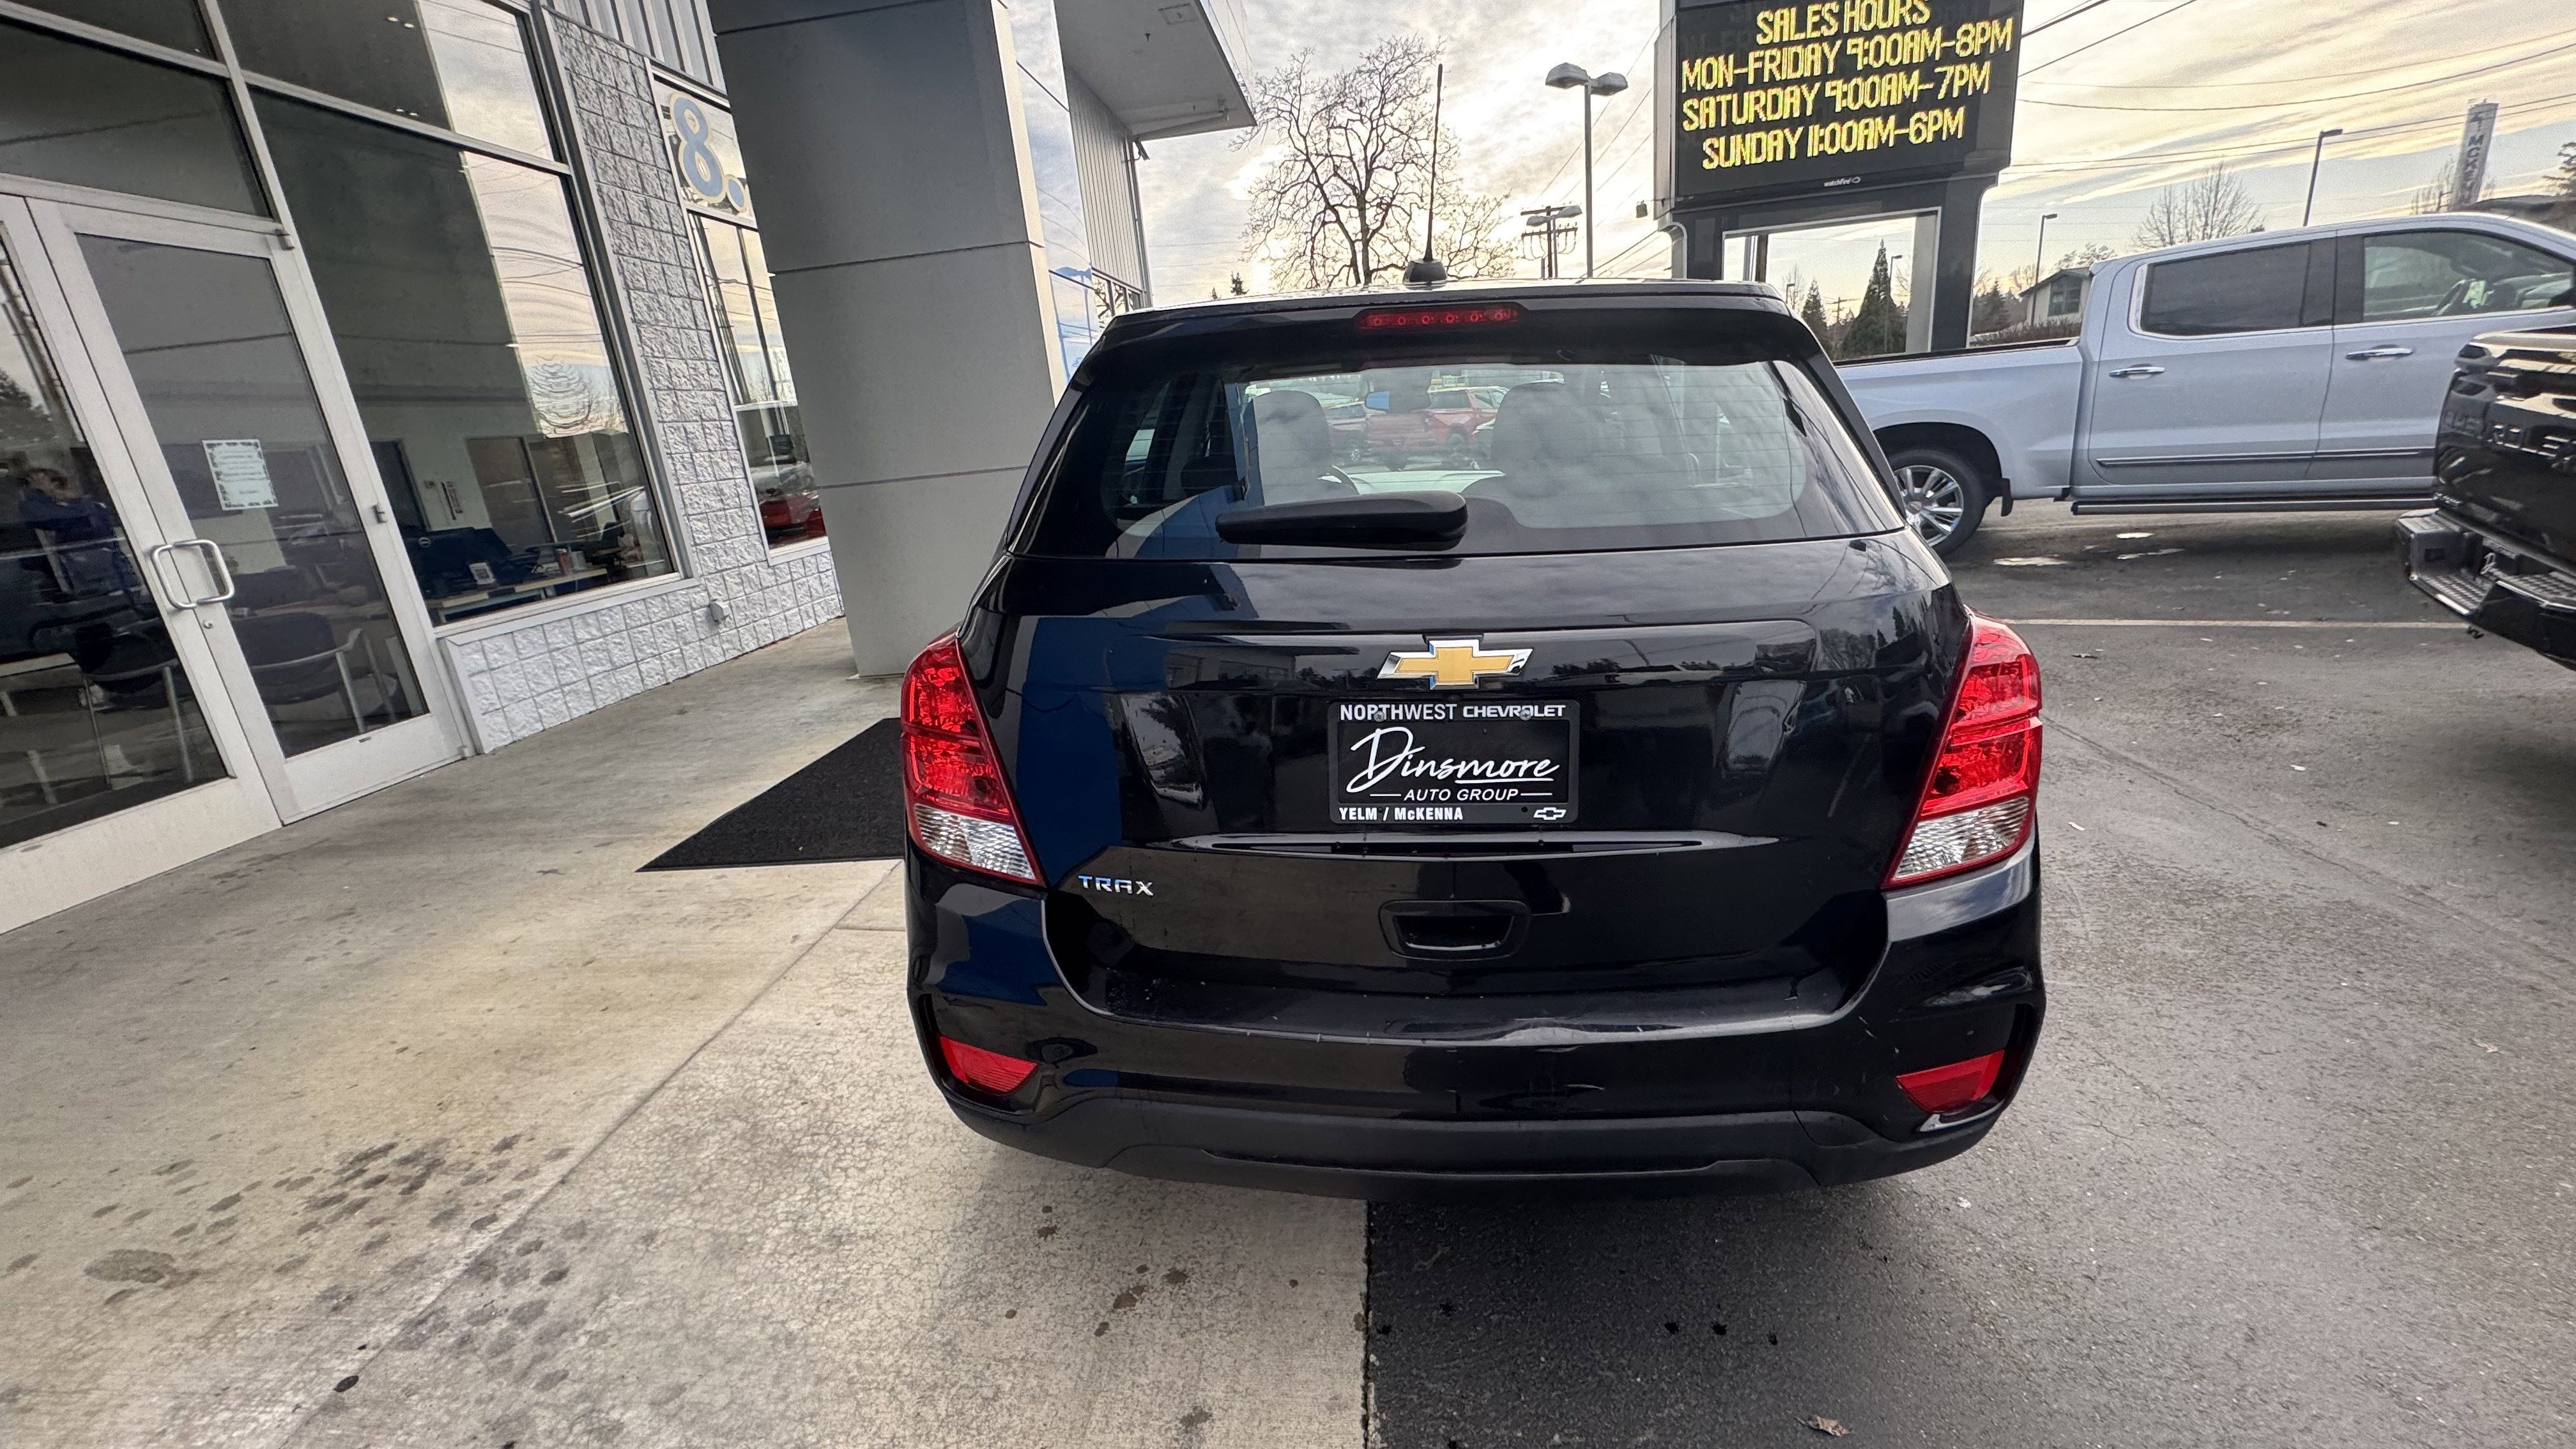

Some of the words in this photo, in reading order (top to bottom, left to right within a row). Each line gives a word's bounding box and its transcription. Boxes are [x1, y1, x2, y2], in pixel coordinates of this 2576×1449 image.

[1756, 6, 1840, 45] SALES
[1843, 0, 1931, 34] HOURS
[1681, 39, 1843, 93] MON-FRIDAY
[1846, 17, 2014, 70] 9:00AM-8PM
[1682, 82, 1818, 132] SATURDAY
[1825, 60, 1992, 114] 9:00AM-7PM
[1701, 126, 1805, 170] SUNDAY
[1807, 106, 1966, 157] 11:00AM-6PM
[1340, 703, 1457, 721] NORTHWEST
[1462, 705, 1567, 718] CHEVROLET
[1346, 726, 1561, 793] Dinsmore
[1339, 808, 1377, 820] YELM
[1394, 807, 1464, 821] McKENNA
[1404, 790, 1451, 802] AUTO
[1457, 788, 1519, 802] GROUP
[1078, 875, 1154, 897] TRAX
